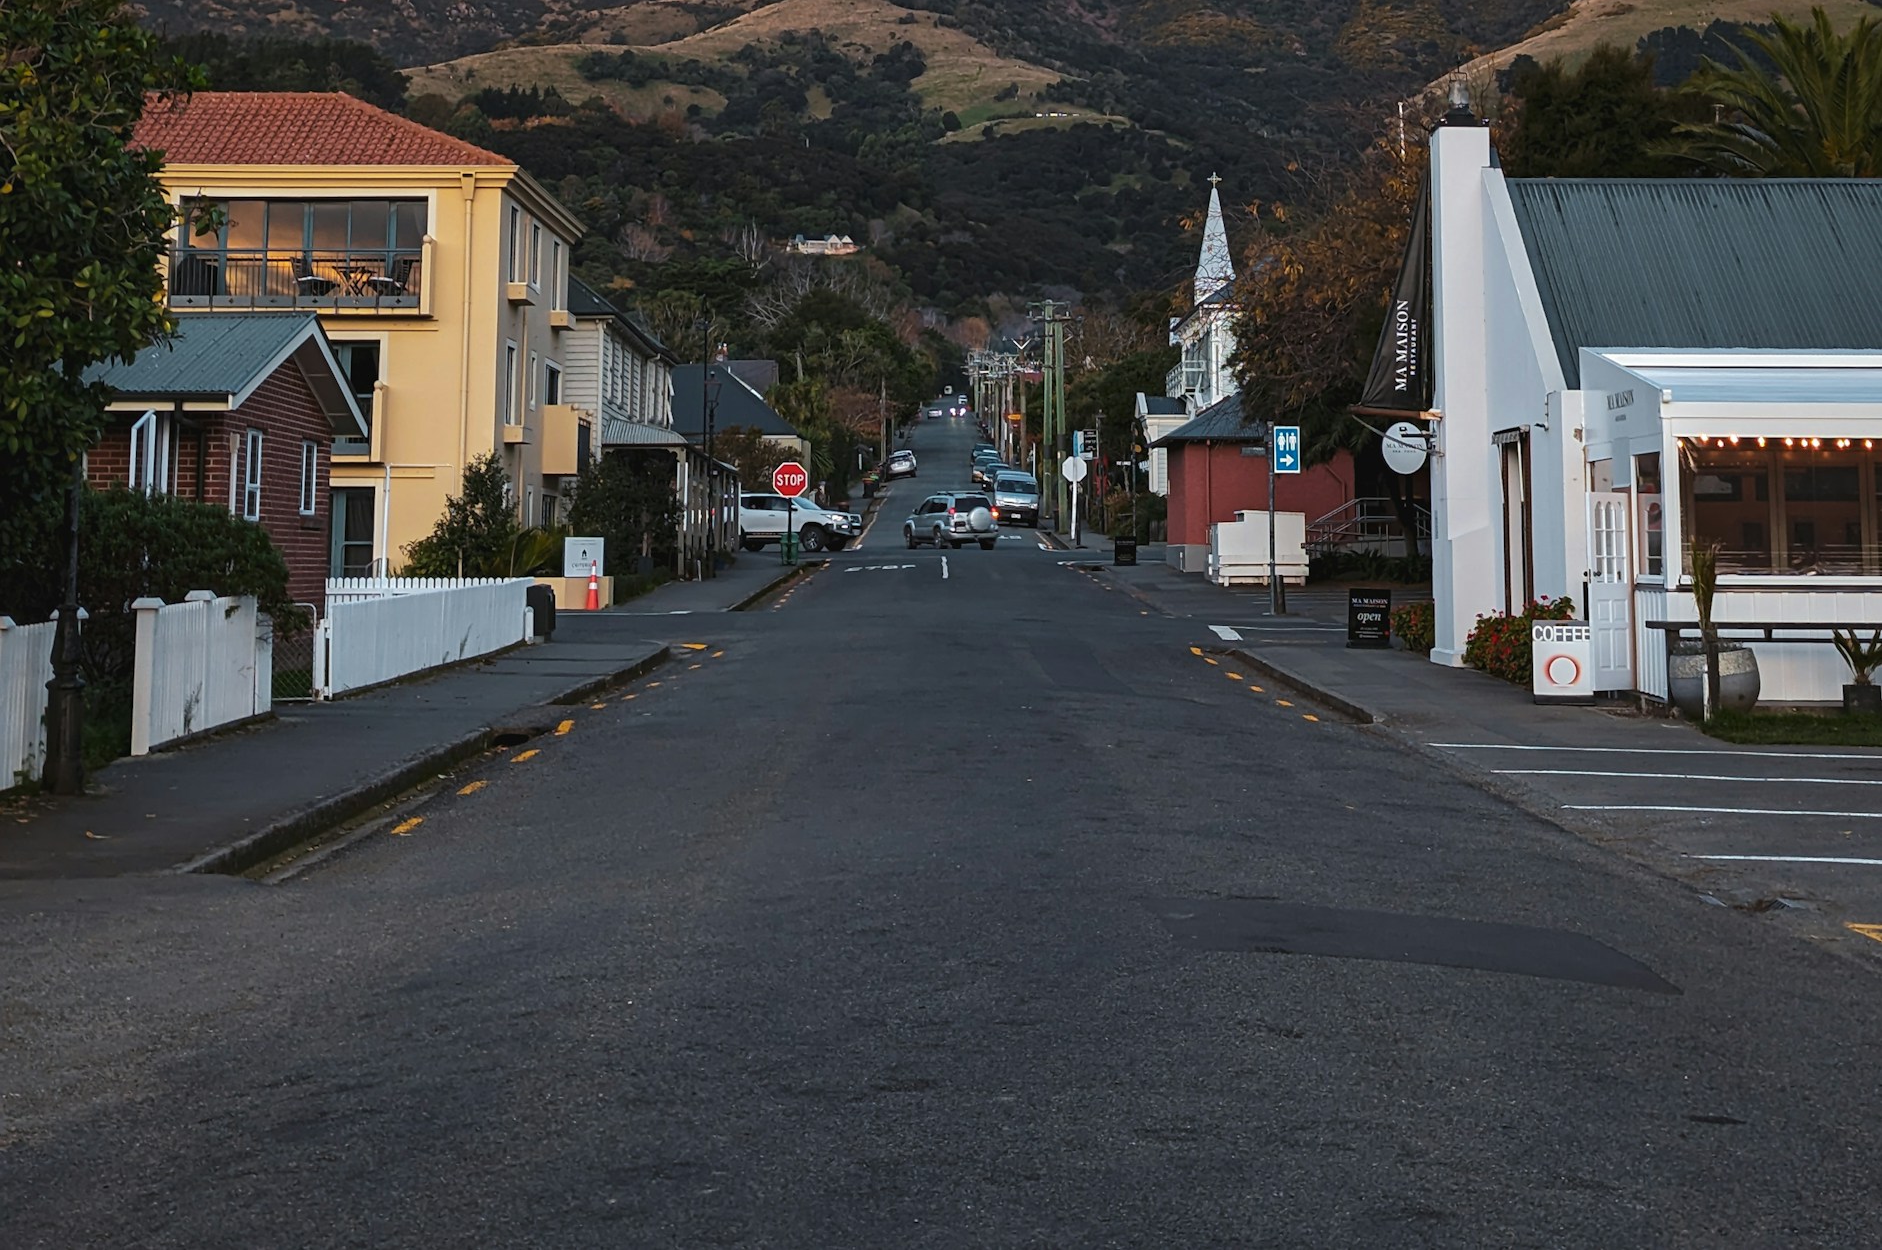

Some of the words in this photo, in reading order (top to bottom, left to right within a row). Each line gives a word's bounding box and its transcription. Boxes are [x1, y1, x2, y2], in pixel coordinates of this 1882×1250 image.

[1396, 299, 1409, 363] MAISON
[1395, 367, 1407, 391] MA
[776, 474, 804, 487] STOP
[1357, 612, 1382, 624] open
[1532, 625, 1590, 642] COFFEE
